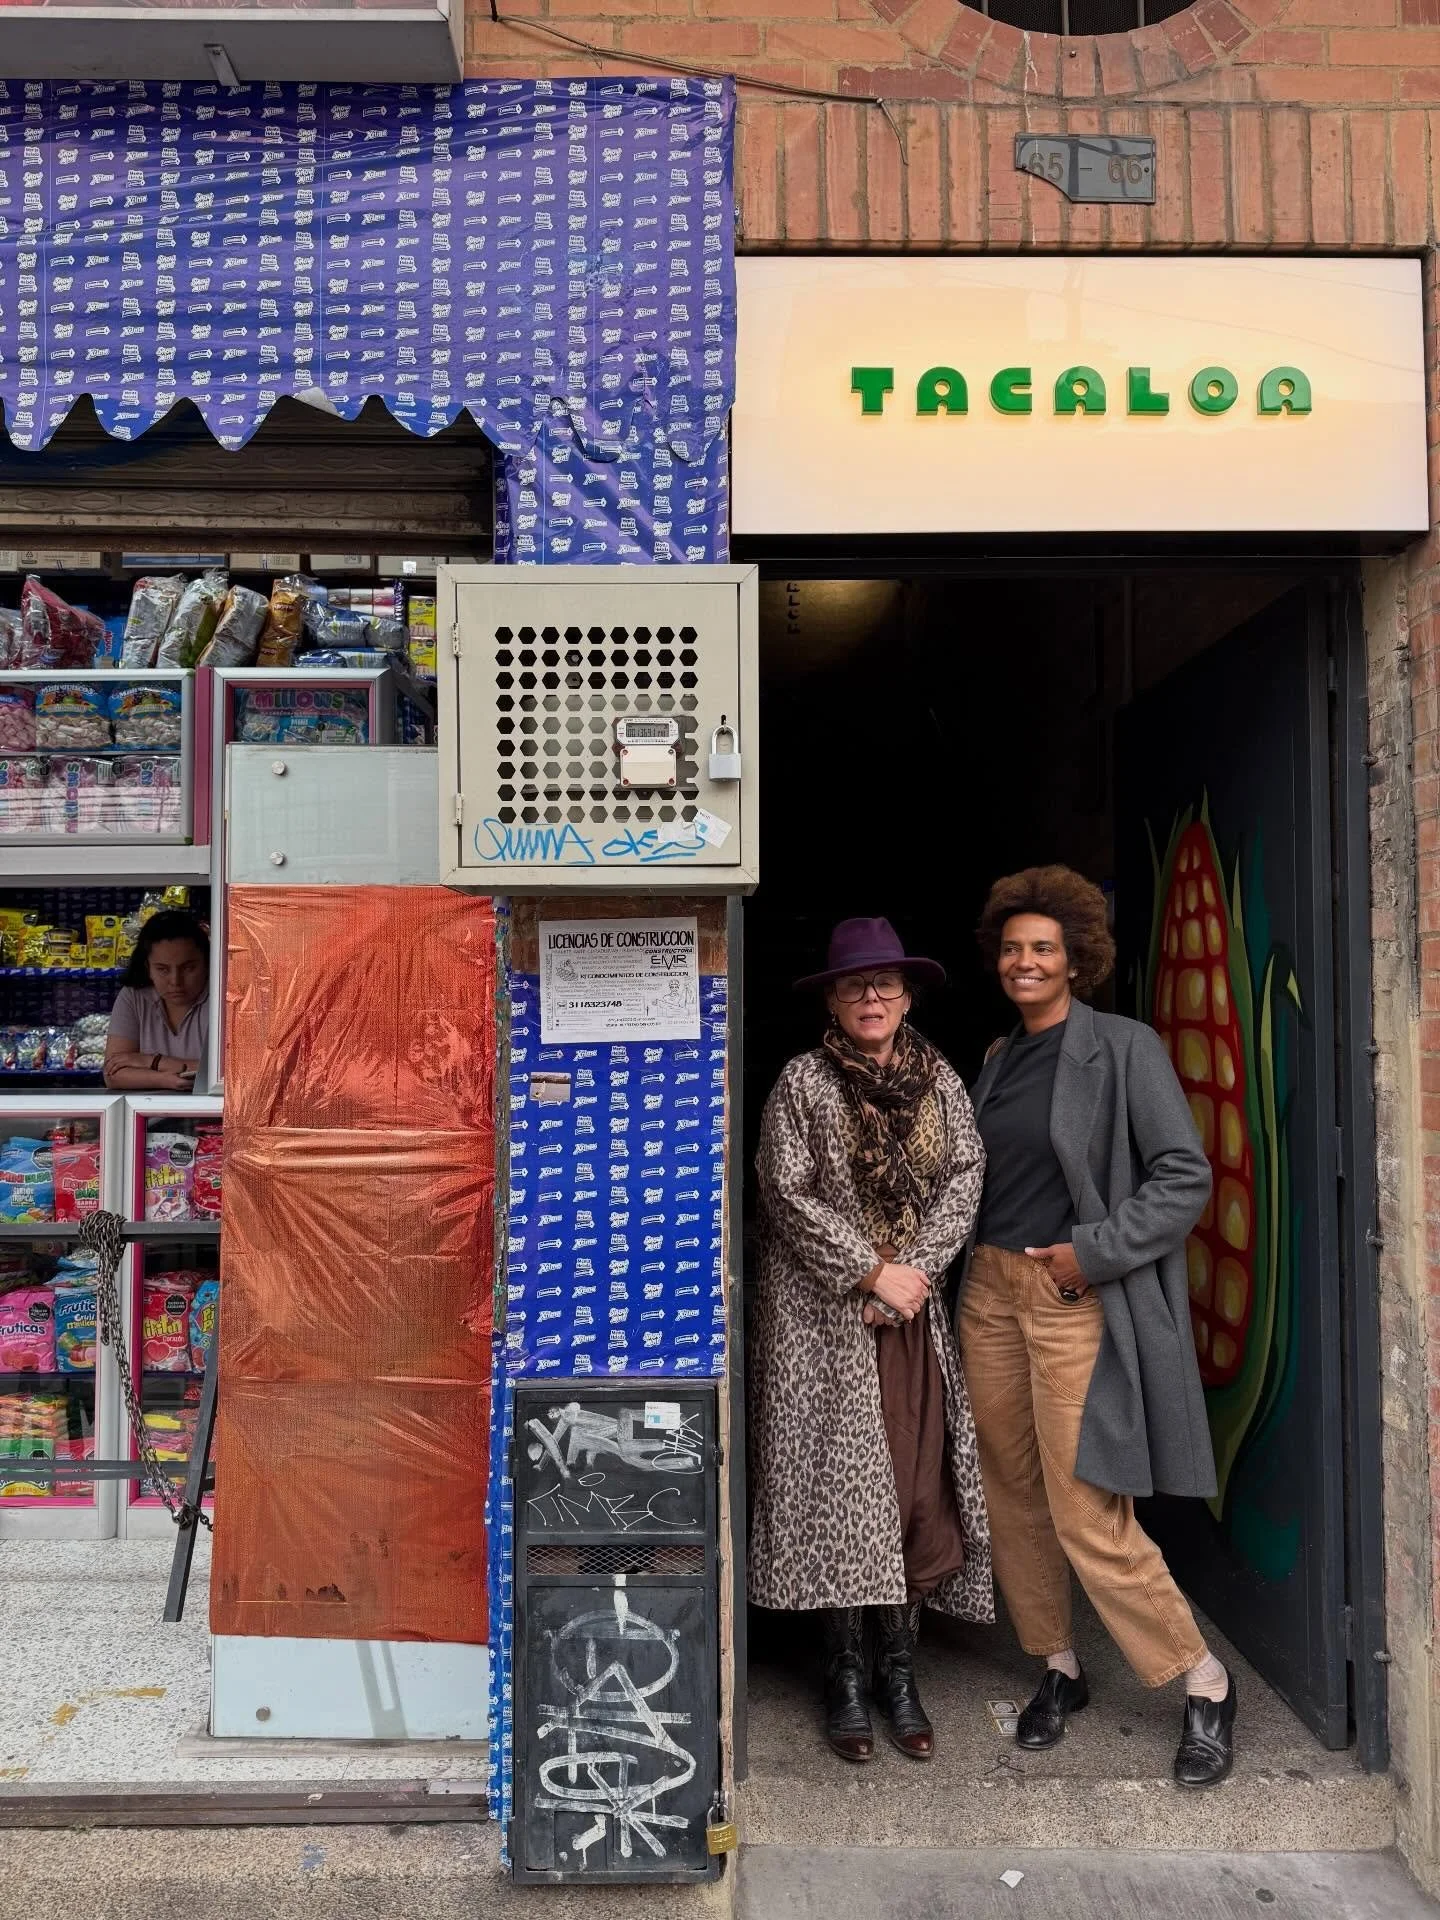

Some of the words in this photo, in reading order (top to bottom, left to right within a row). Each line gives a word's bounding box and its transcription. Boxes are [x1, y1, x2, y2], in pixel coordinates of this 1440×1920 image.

[1029, 152, 1064, 183] 65
[1108, 155, 1142, 183] 66
[851, 366, 1312, 417] TACALOA
[548, 933, 598, 949] LICENCIAS
[601, 932, 614, 947] DE
[617, 931, 694, 947] CONSTRUCCION
[59, 1299, 96, 1316] Frutic
